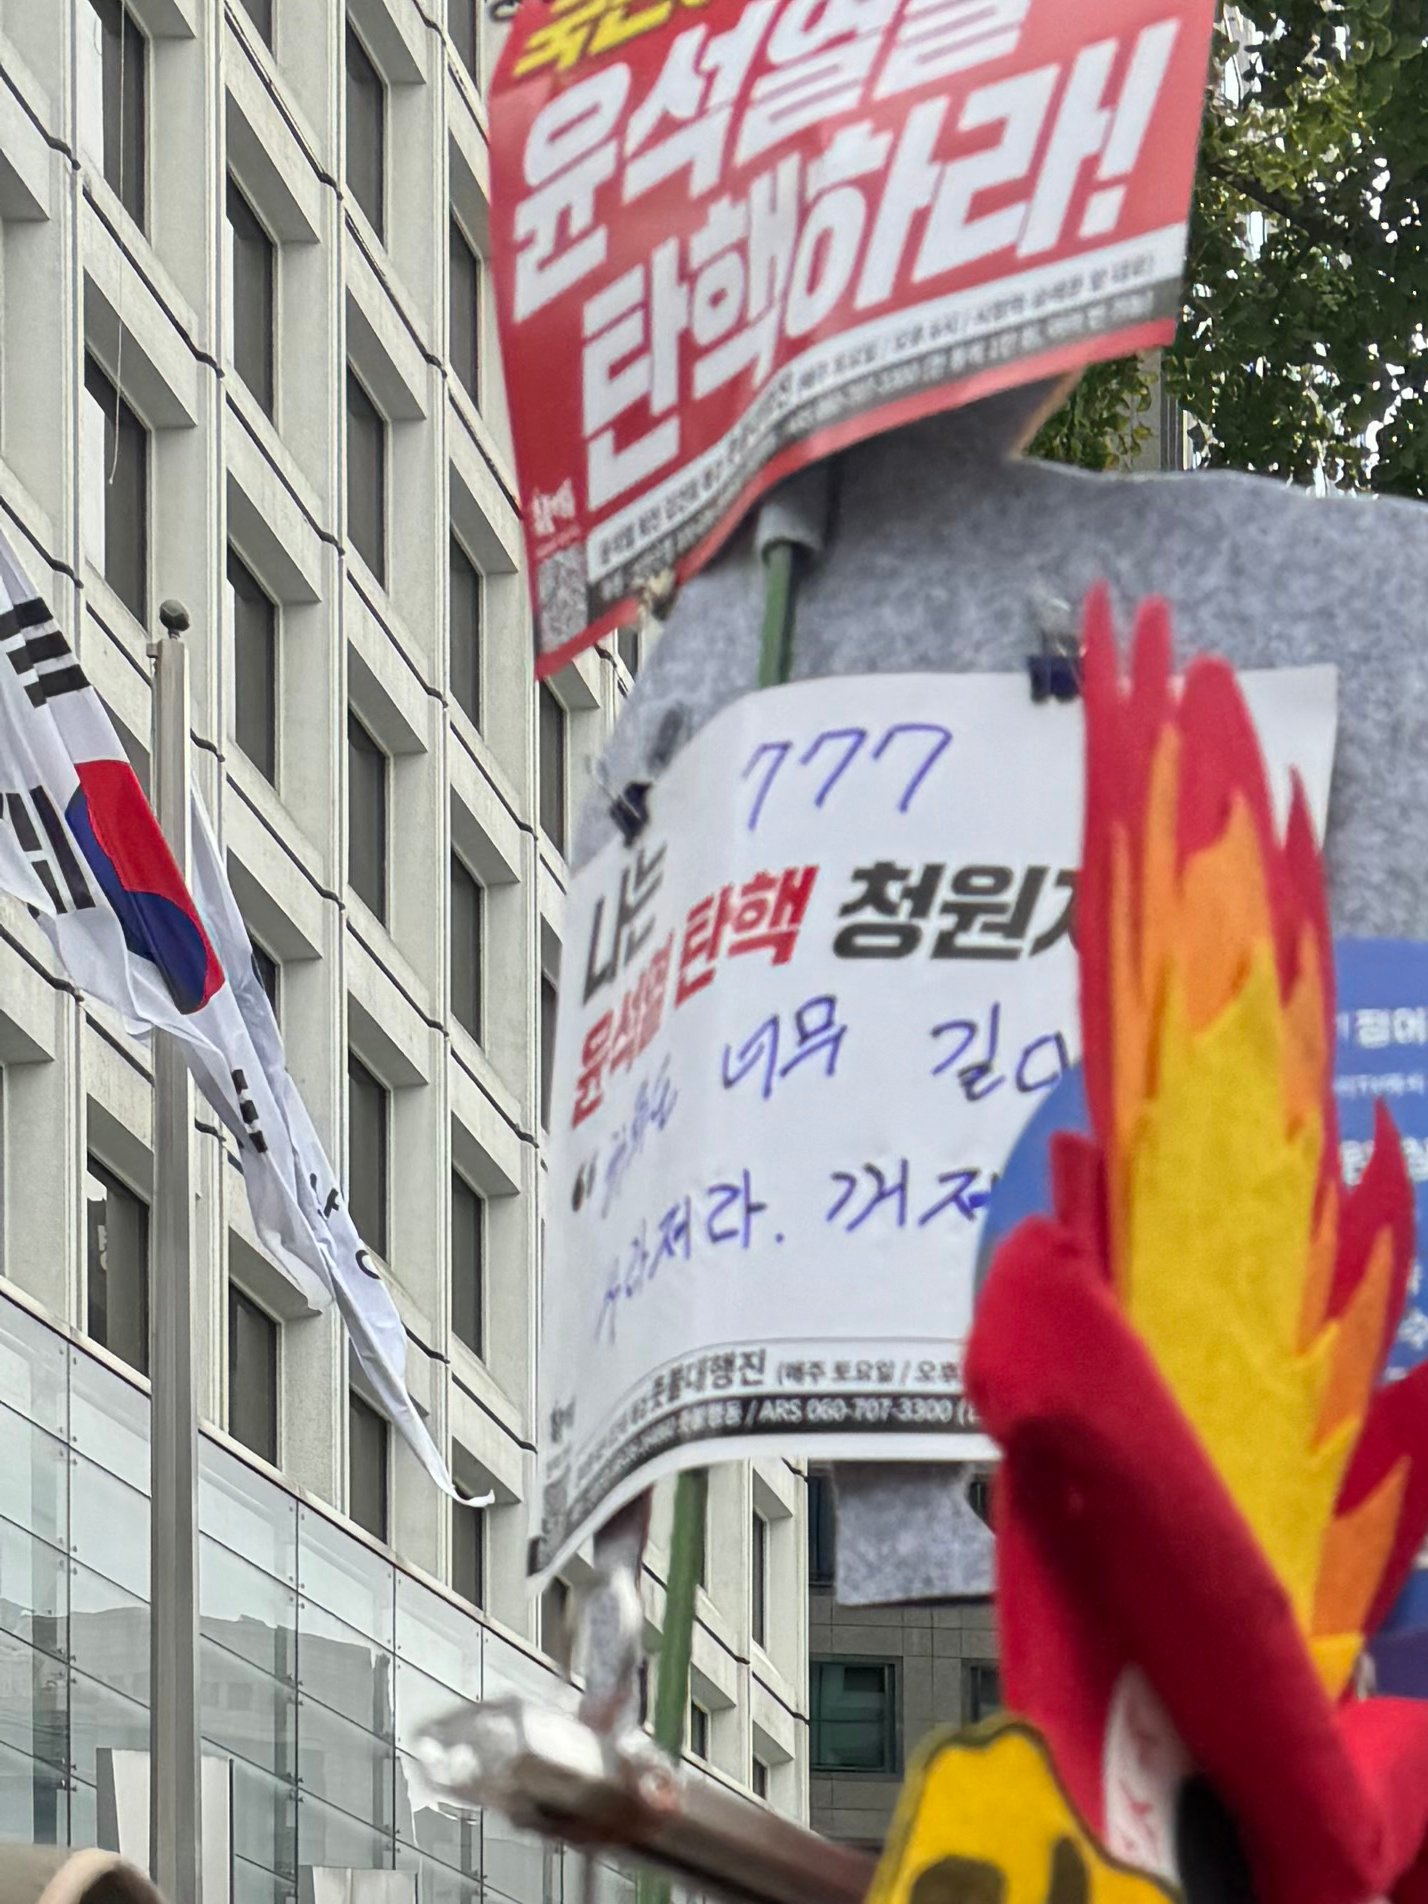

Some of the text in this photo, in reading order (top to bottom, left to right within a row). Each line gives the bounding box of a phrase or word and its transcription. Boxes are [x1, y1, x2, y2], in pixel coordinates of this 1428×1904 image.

[583, 20, 1182, 512] 탄핵하라!
[742, 722, 954, 832] 777
[583, 840, 670, 1006] 나는
[674, 863, 821, 1010] 탄핵
[721, 992, 849, 1102] 너무
[758, 1402, 802, 1424] ARS
[805, 1399, 952, 1425] 060-707-3300
